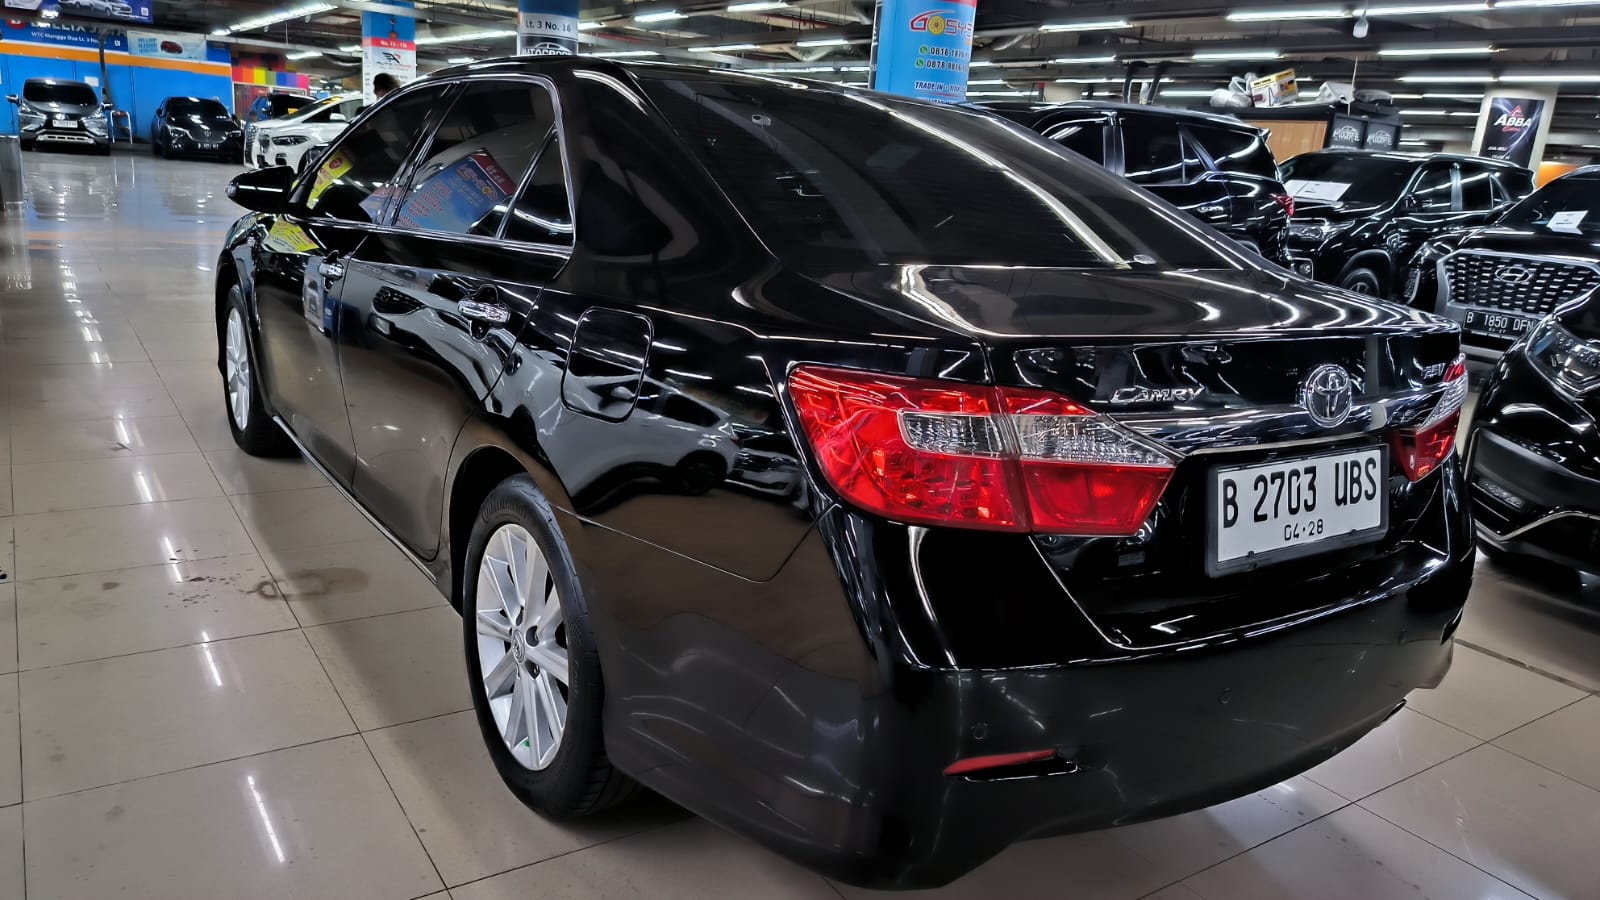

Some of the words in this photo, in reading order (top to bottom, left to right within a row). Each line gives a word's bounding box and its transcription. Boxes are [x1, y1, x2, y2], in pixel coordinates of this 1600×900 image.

[536, 20, 543, 28] 3
[545, 21, 560, 31] No.
[562, 23, 572, 32] 16
[930, 46, 949, 57] 0816
[926, 60, 945, 69] 0878
[915, 81, 936, 90] TRADE
[936, 83, 944, 91] IN
[1493, 113, 1533, 127] ABBA
[1466, 311, 1474, 323] B
[1483, 314, 1508, 329] 1850
[1512, 318, 1534, 333] DFN
[1110, 387, 1206, 404] CAMRY
[1223, 478, 1239, 528] B
[1253, 465, 1317, 523] 2703
[1334, 457, 1377, 507] UBS
